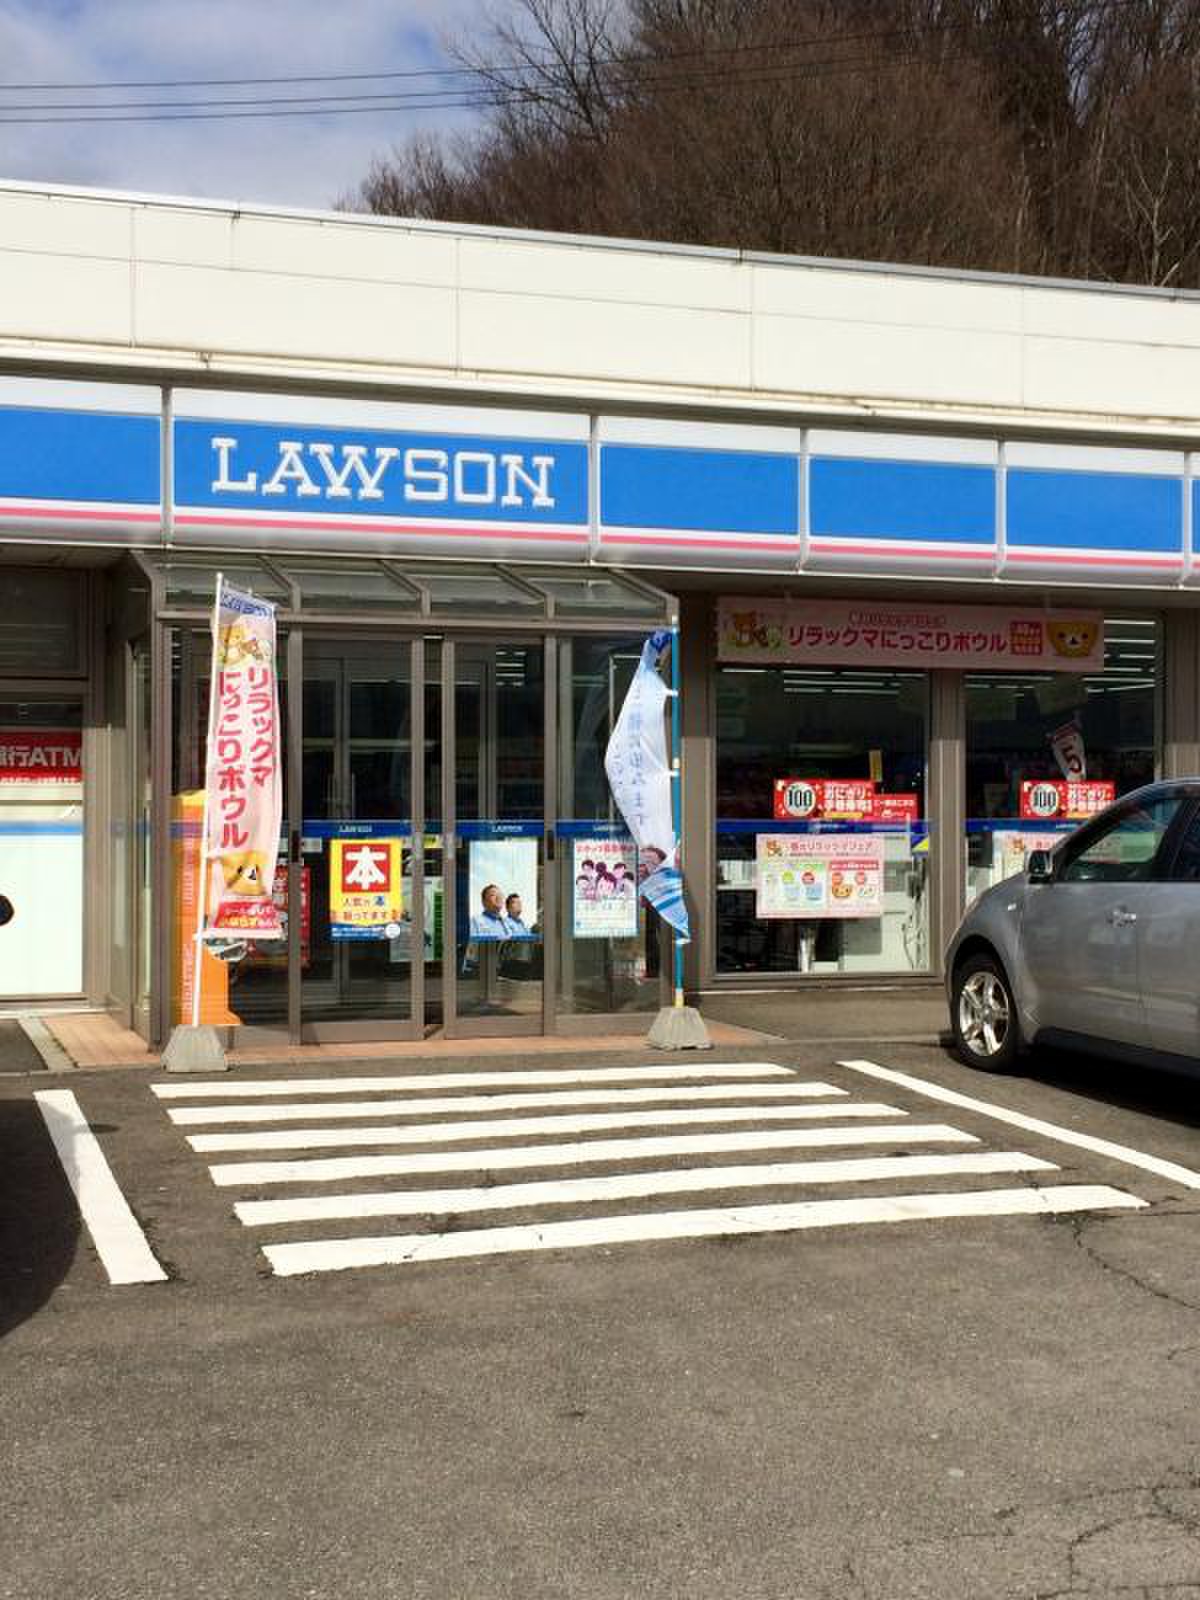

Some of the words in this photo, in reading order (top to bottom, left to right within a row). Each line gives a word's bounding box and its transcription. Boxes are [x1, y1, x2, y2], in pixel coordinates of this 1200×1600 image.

[211, 437, 556, 508] LAWSON
[787, 624, 1008, 654] リラックマにっこりボウル
[247, 666, 274, 788] リラックマ
[217, 671, 250, 849] にっこりボウル
[788, 789, 813, 808] 100
[345, 845, 387, 890] 本
